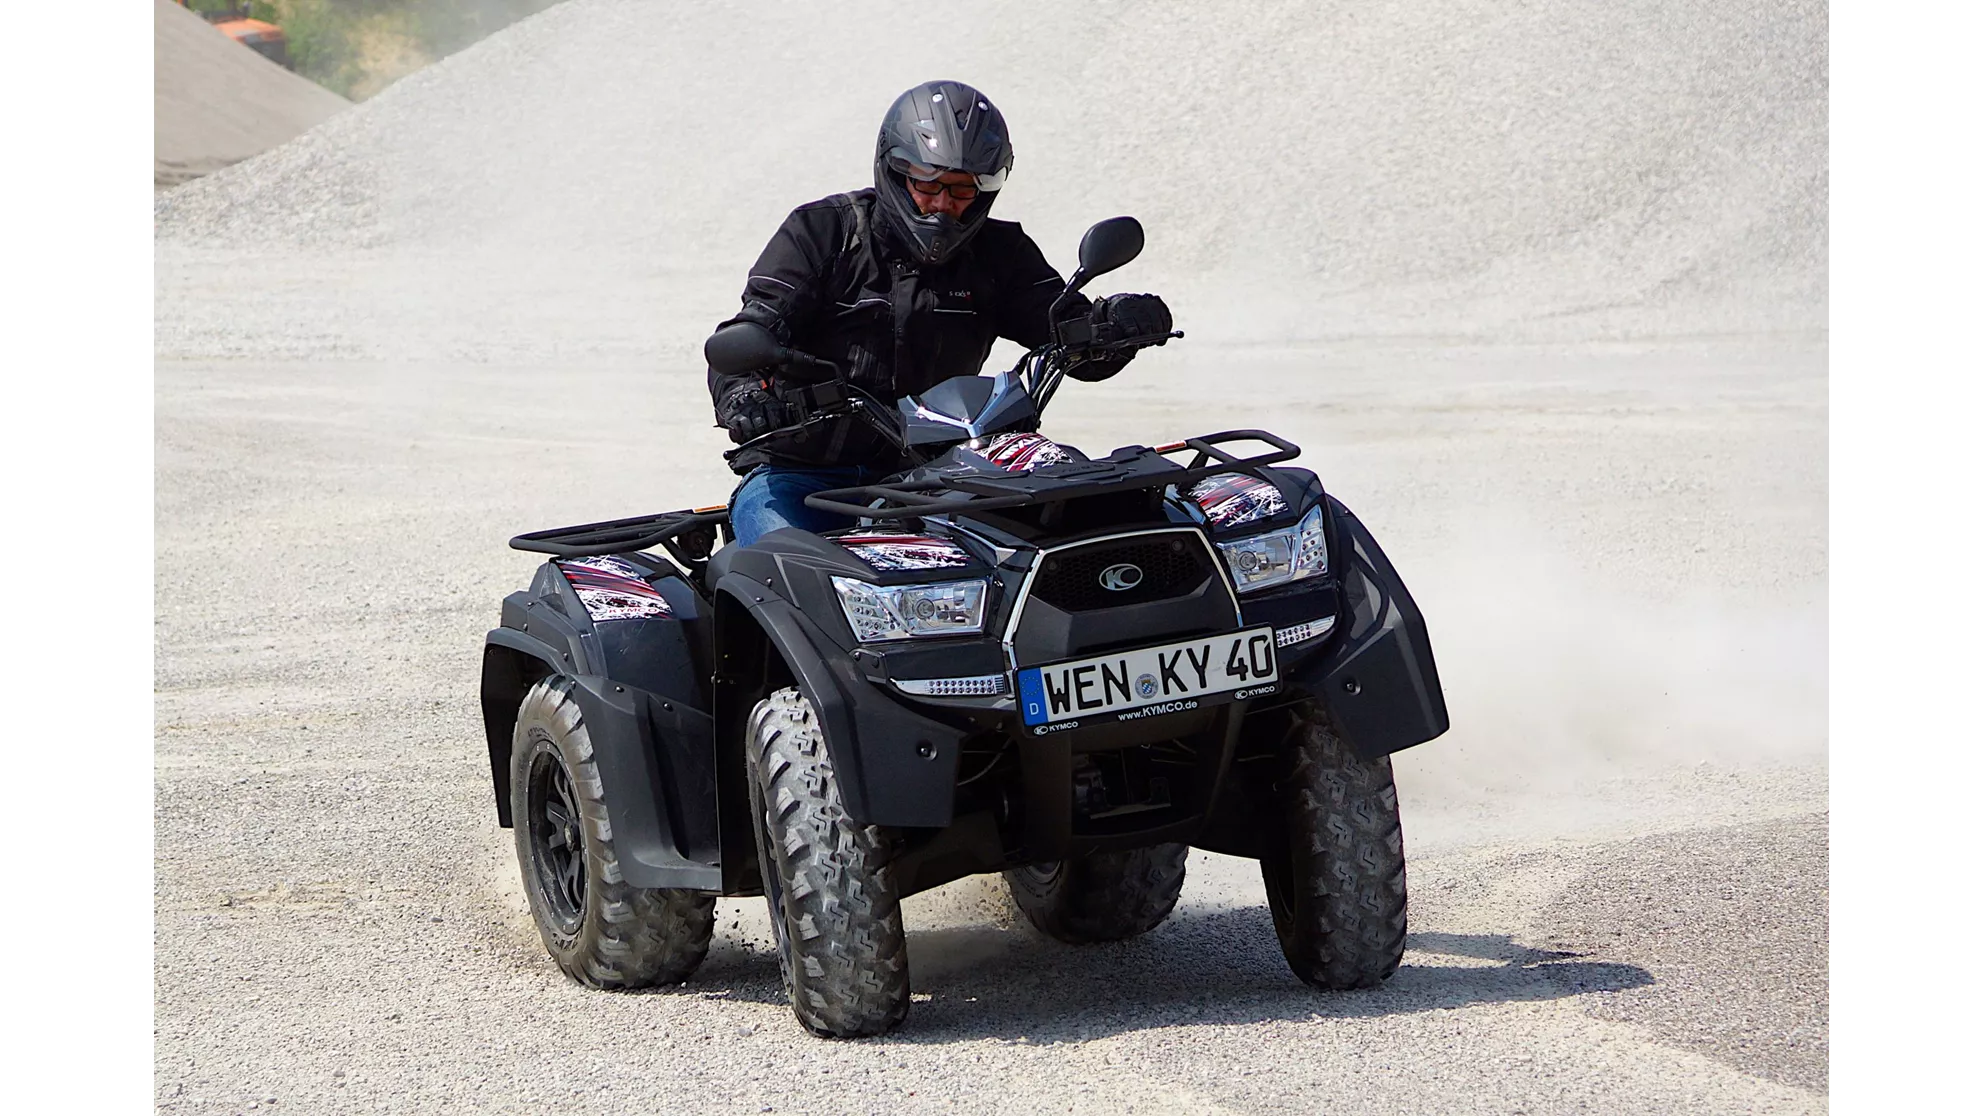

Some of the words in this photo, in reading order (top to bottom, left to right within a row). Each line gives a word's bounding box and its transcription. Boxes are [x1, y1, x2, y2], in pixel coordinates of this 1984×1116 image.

[1044, 659, 1131, 715] WEN
[1158, 644, 1210, 695] KY
[1226, 634, 1274, 681] 40
[1248, 685, 1275, 696] KYMCO
[1029, 702, 1039, 715] D
[1118, 700, 1198, 721] www.KYMCO.de
[1049, 721, 1078, 732] KYMCO
